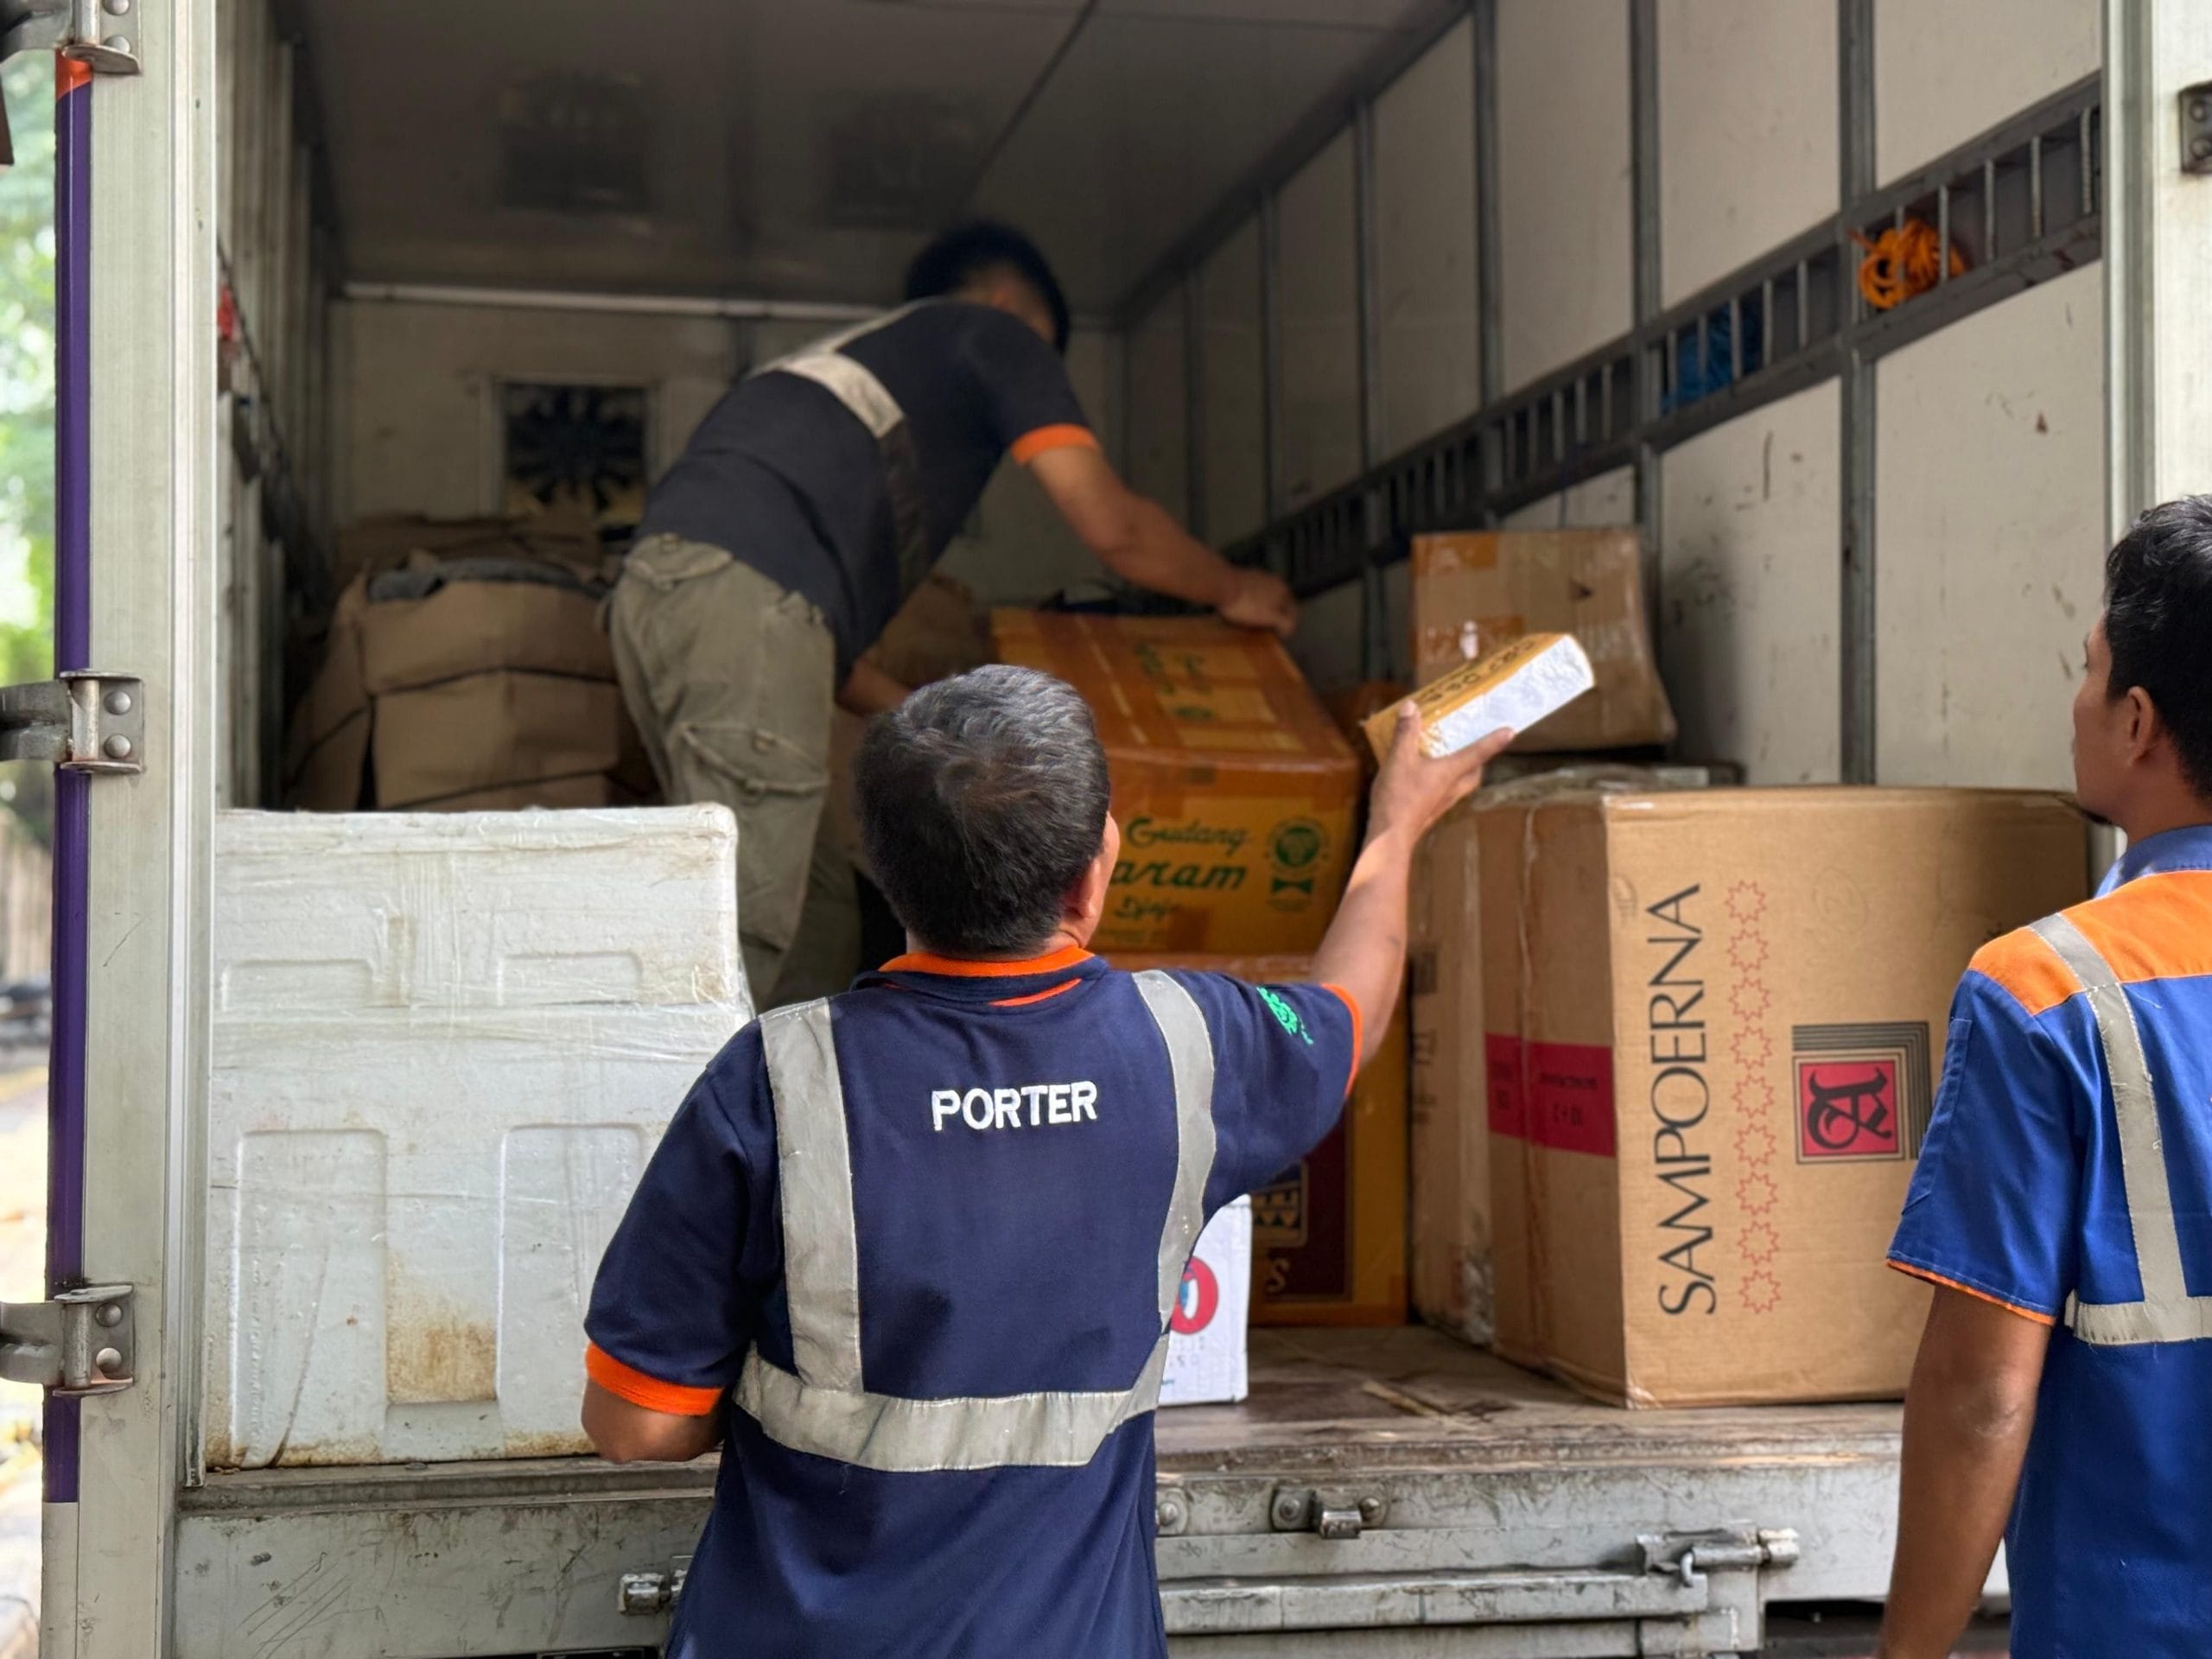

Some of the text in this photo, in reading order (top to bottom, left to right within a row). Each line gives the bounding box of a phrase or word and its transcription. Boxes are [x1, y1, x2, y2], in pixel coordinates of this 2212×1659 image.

[1110, 859, 1248, 891] aram
[931, 1080, 1098, 1132] PORTER
[1646, 883, 1717, 1316] SAMPOERNA
